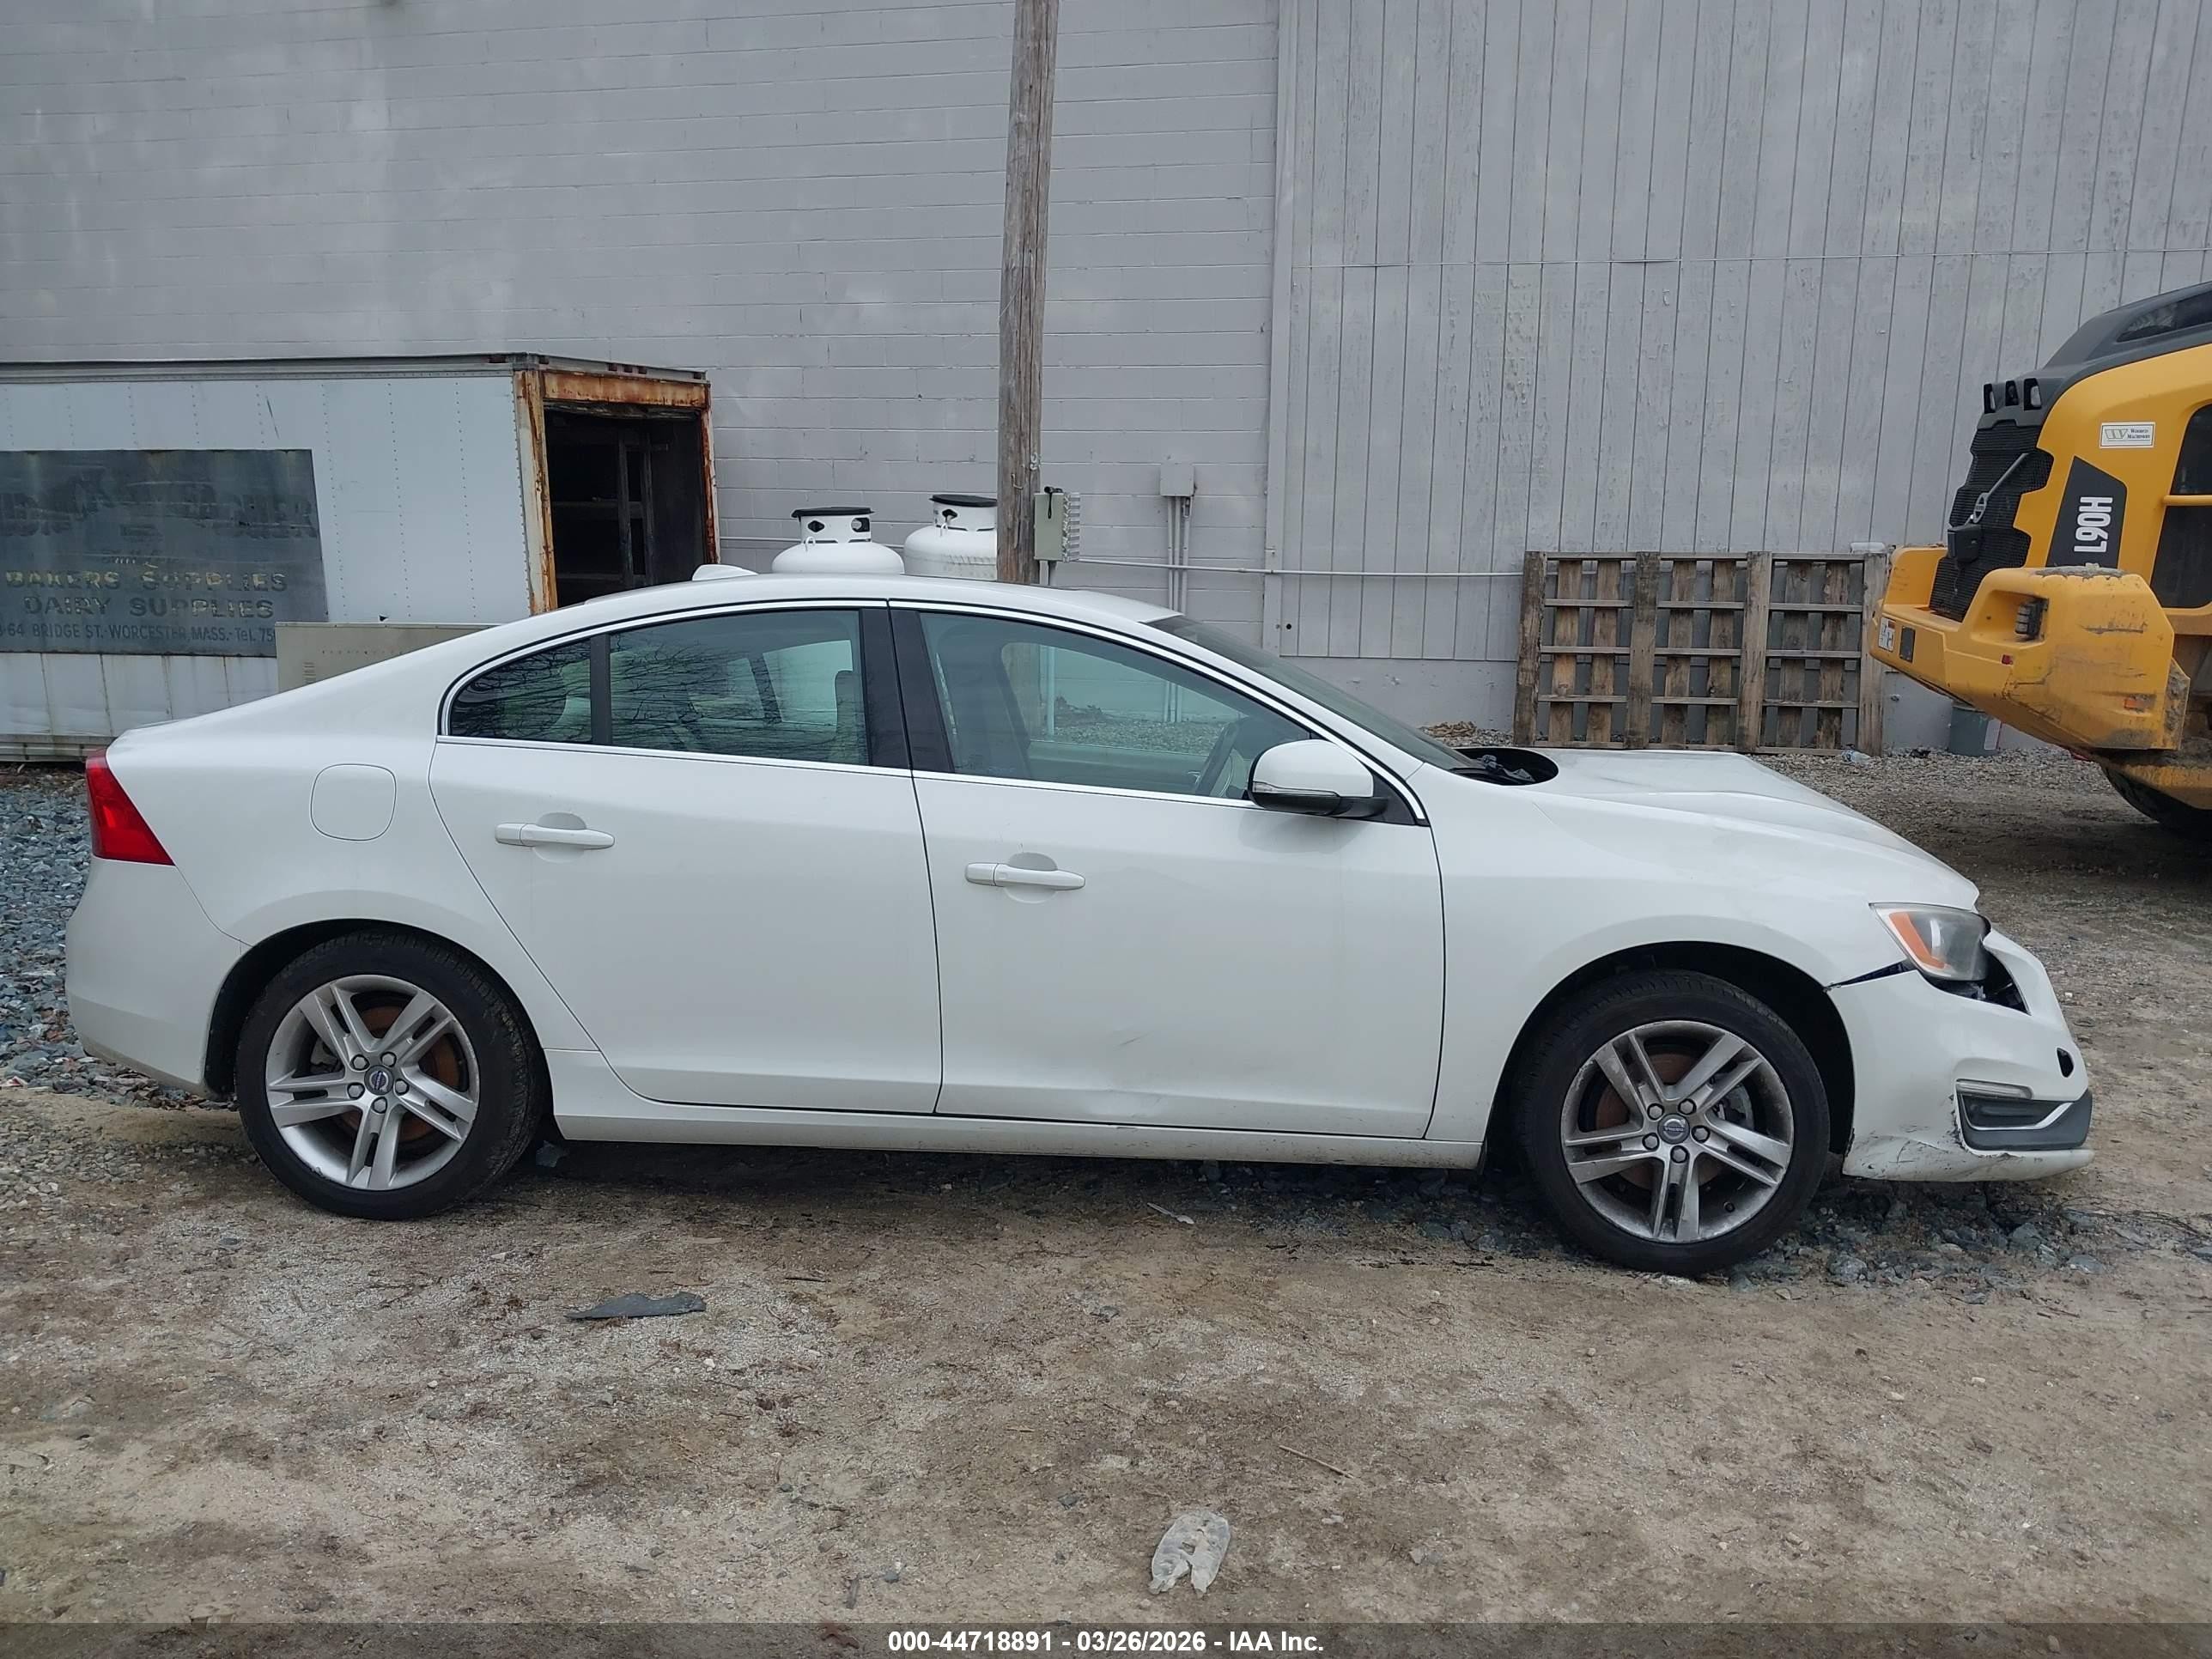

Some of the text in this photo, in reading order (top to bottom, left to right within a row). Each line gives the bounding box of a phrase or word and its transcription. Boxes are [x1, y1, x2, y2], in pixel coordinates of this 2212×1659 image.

[2074, 496, 2113, 553] L90H
[6, 570, 289, 592] BAKERS SUPPLIES
[23, 596, 275, 619] DAIRY SUPPLIES
[32, 623, 81, 637] BRIDGE
